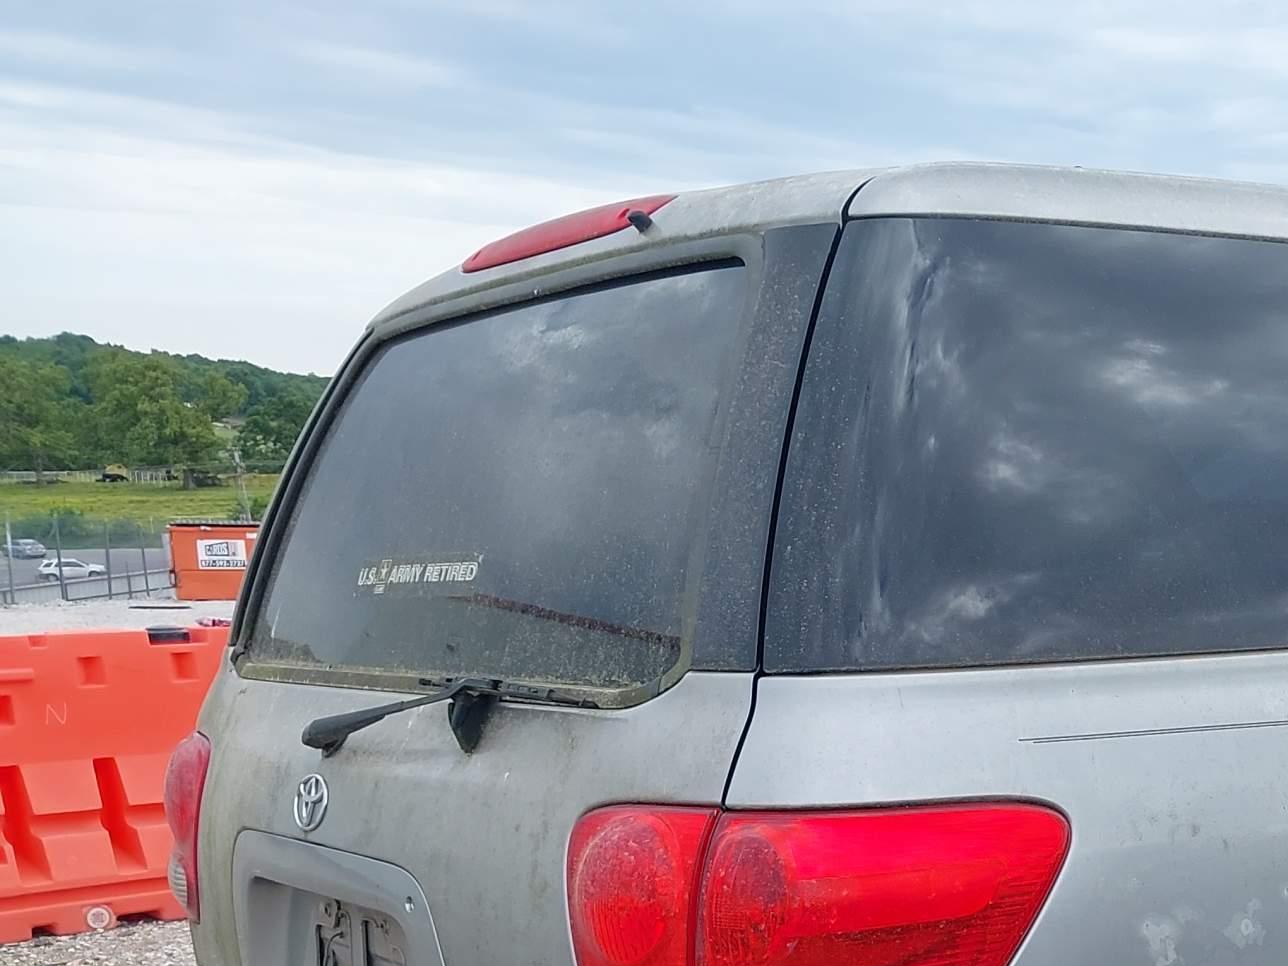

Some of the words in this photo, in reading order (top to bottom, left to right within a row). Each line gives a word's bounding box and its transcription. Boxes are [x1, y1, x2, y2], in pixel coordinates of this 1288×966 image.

[357, 566, 378, 586] U.S.
[387, 564, 424, 584] ARMY
[424, 561, 478, 582] RETIRED
